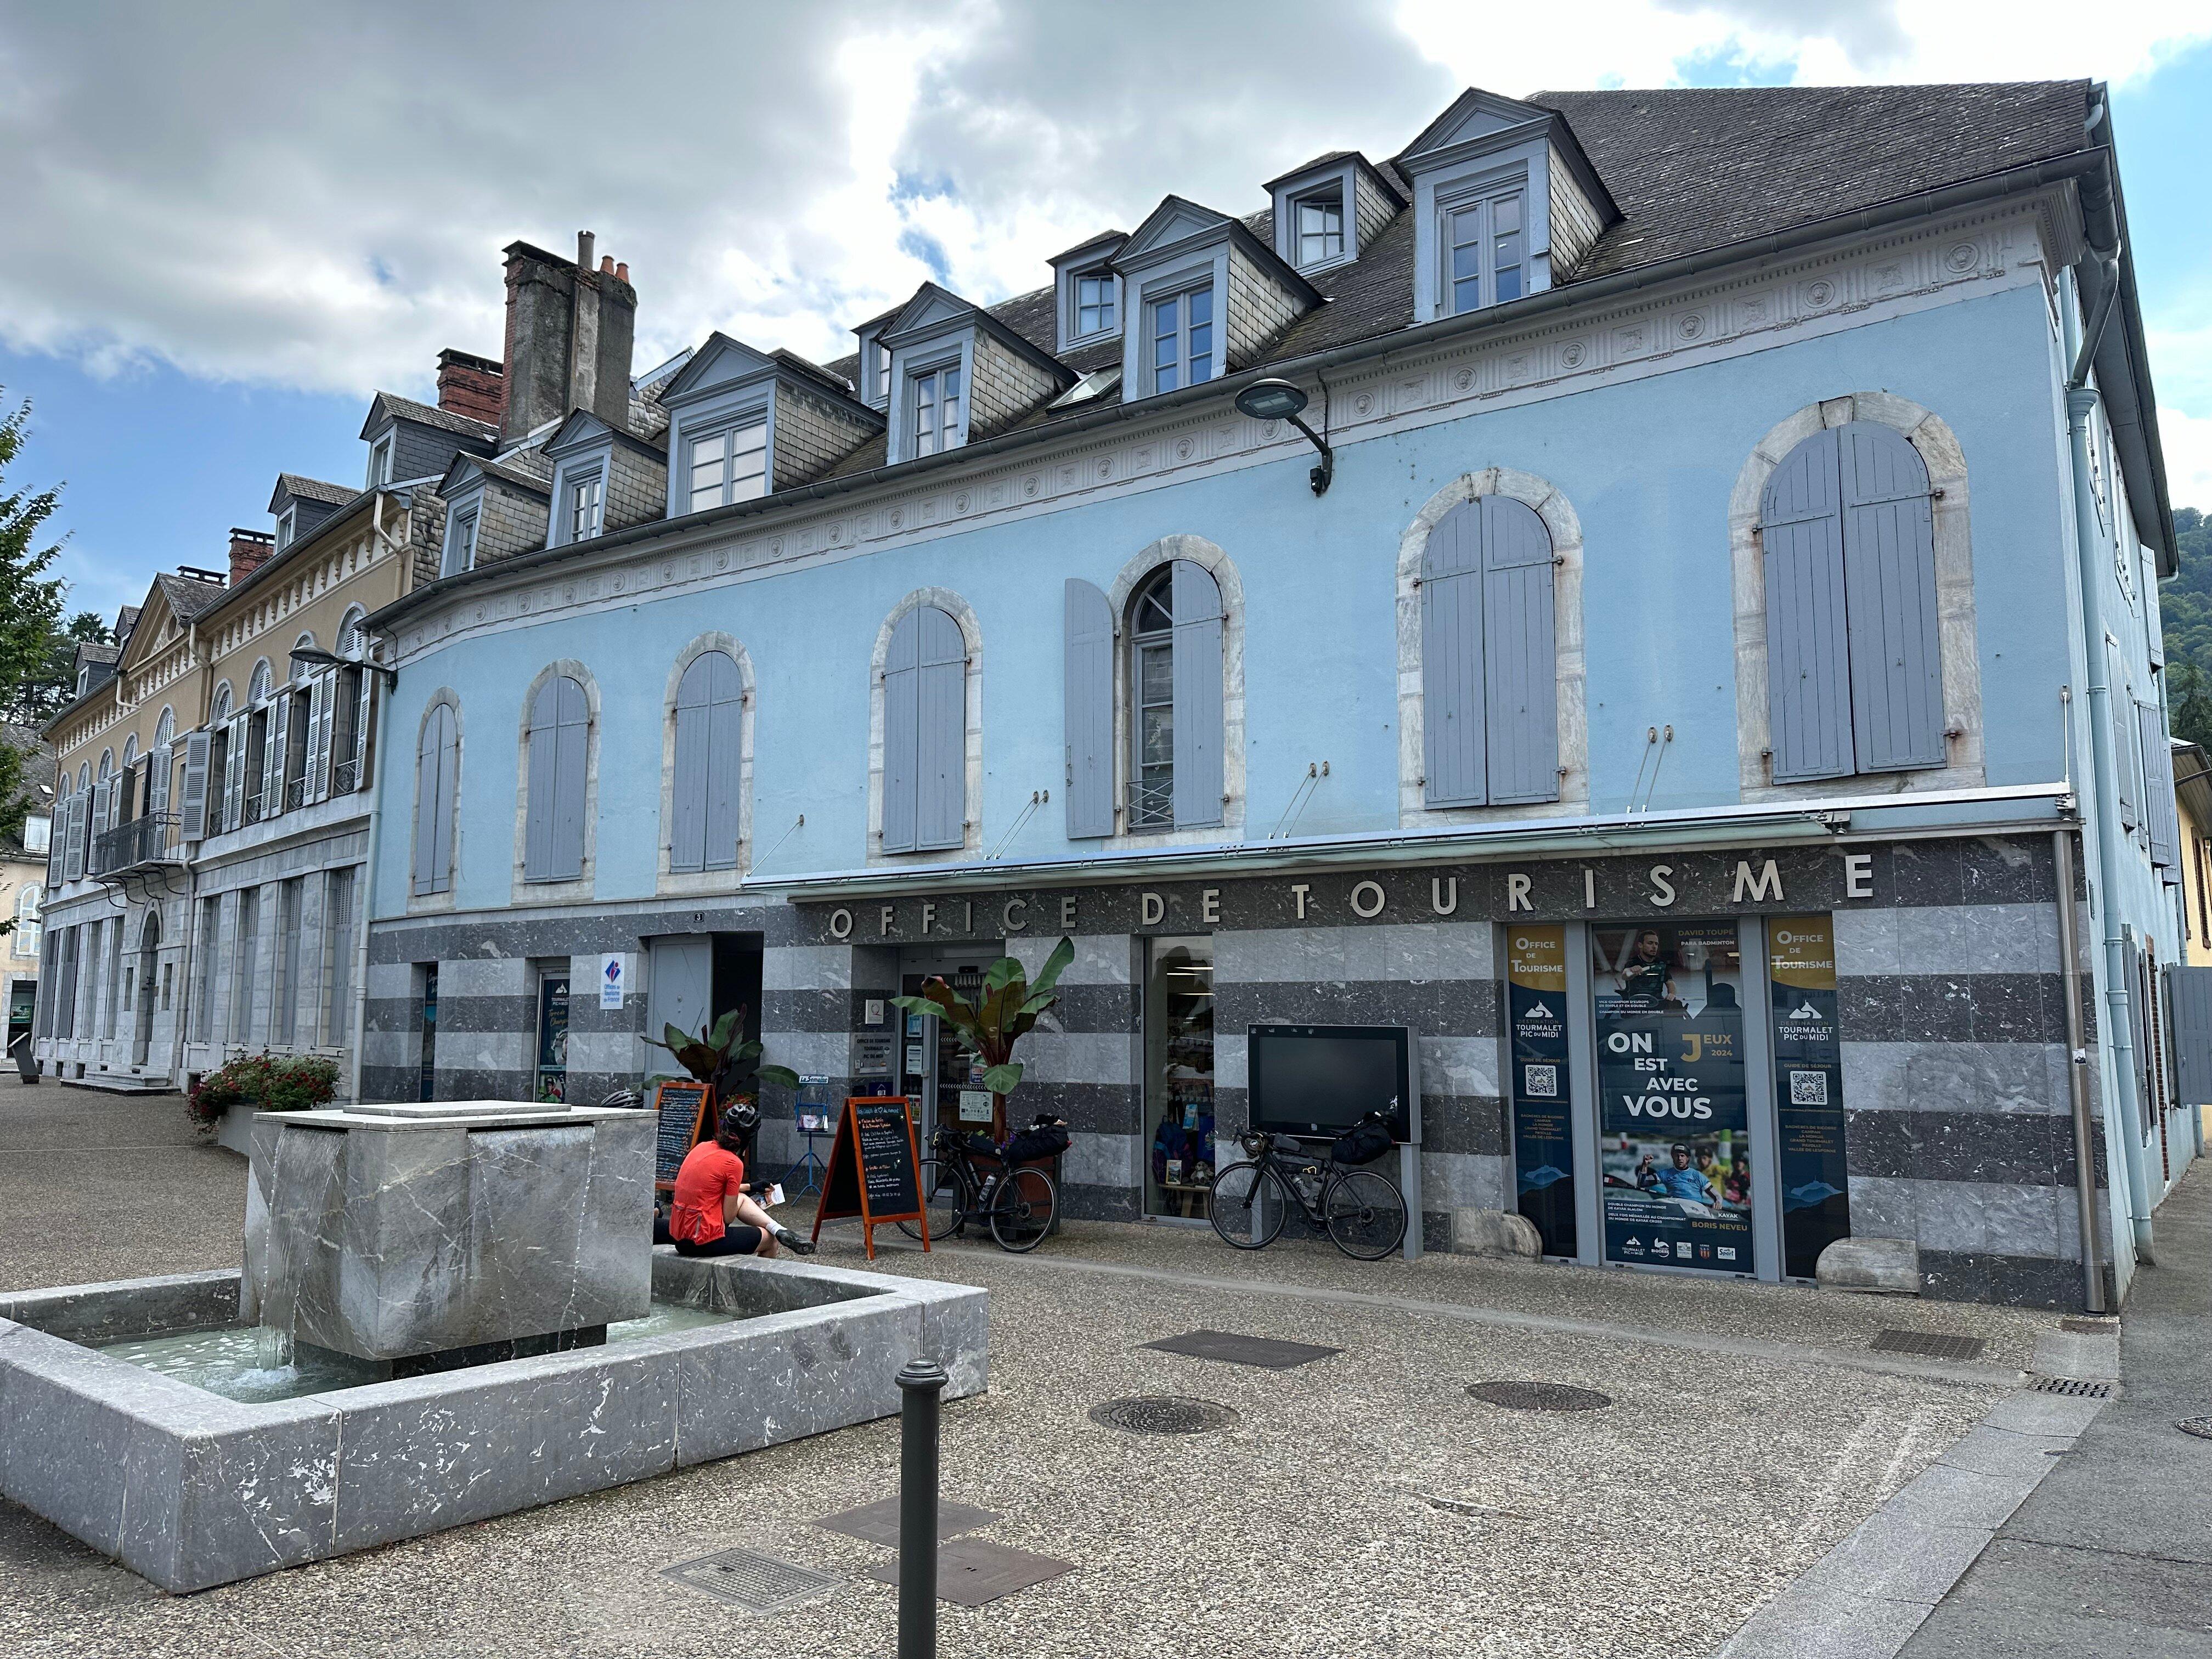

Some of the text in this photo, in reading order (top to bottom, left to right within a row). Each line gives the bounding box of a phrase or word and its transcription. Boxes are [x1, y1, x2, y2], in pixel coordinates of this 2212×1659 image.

[830, 854, 1874, 938] OFFICE DE TOURISME
[1706, 928, 1734, 936] TOUPÉ
[1776, 930, 1824, 944] OFFICE
[1516, 937, 1556, 950] OFFICE
[1511, 960, 1563, 973] TOURISME
[1771, 955, 1833, 969] TOURISME
[1607, 1032, 1652, 1053] ON
[1634, 1058, 1668, 1071] EST
[1646, 1077, 1699, 1092] AVEC
[1622, 1095, 1712, 1119] VOUS
[1719, 1223, 1747, 1231] NEVEU
[1719, 1249, 1734, 1257] Sport
